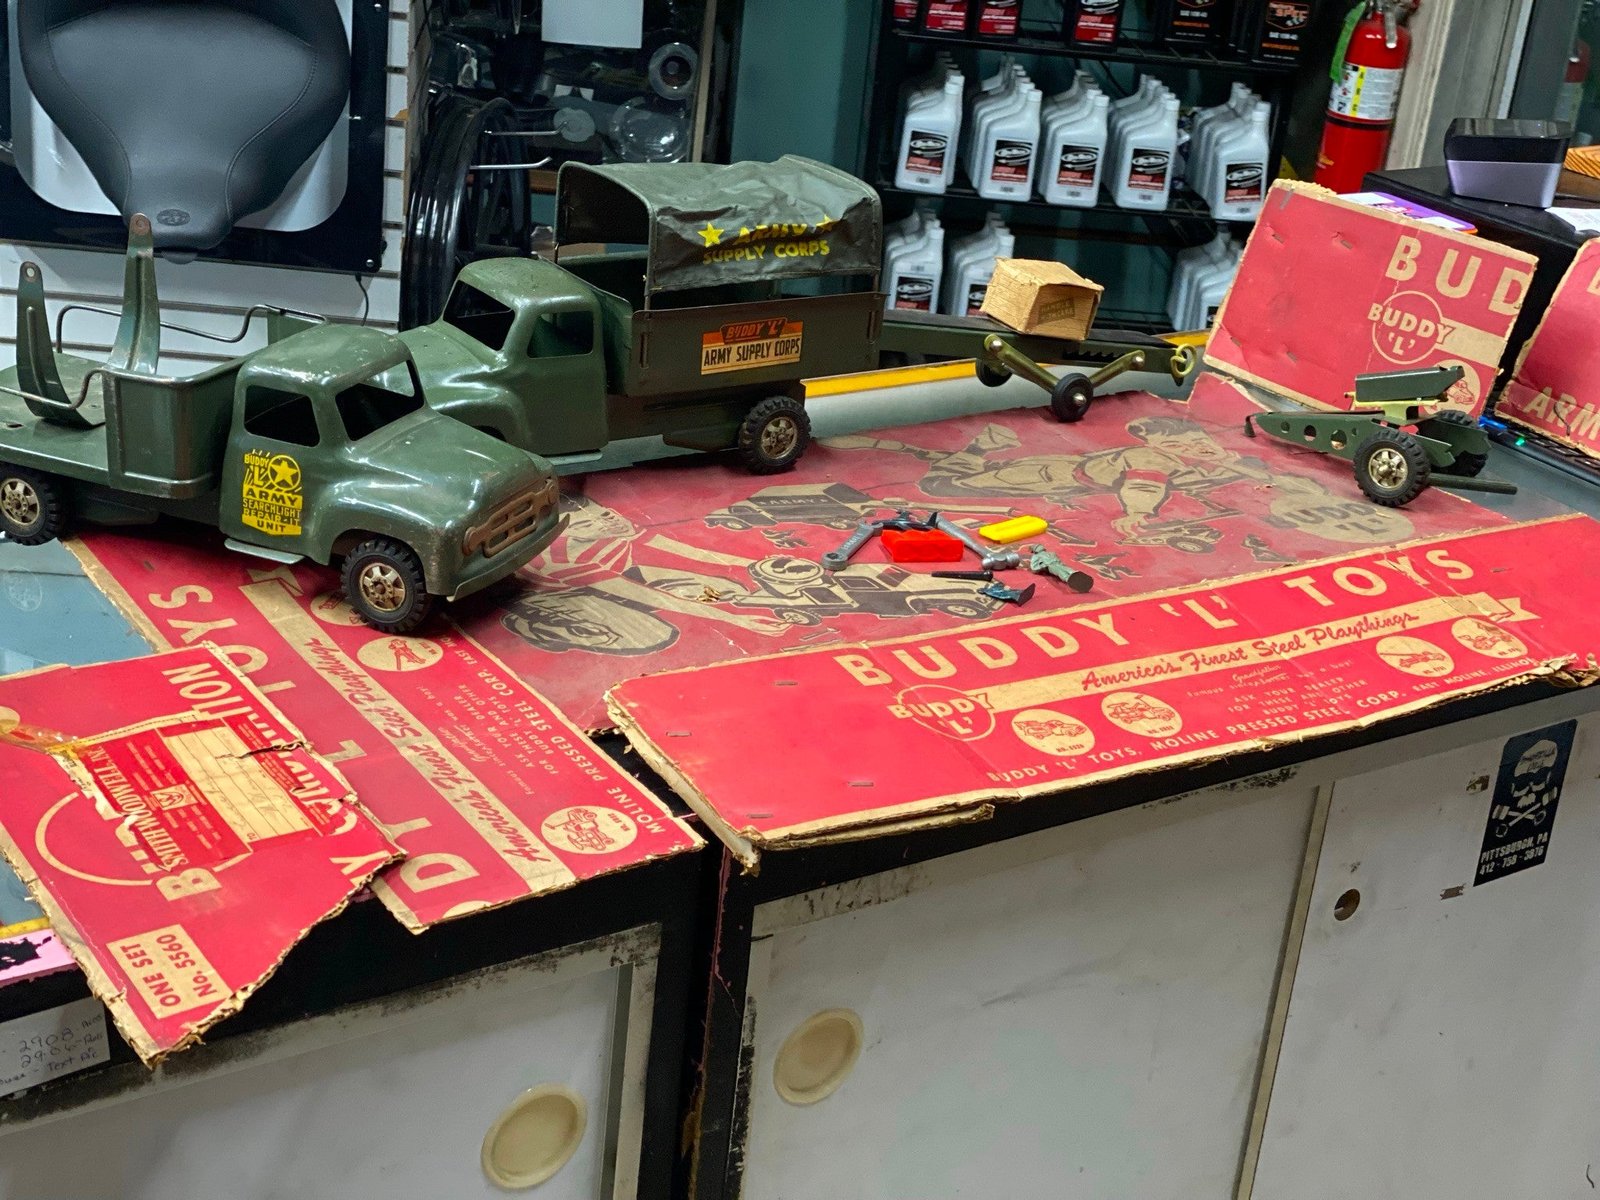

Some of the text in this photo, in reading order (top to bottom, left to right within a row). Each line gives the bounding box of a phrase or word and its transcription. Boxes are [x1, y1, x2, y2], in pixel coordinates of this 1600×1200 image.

[703, 240, 831, 264] SUPPLY CORPS
[725, 323, 763, 339] BUDDY
[1367, 303, 1456, 344] BUDDY
[704, 338, 800, 367] ARMY SUPPLY CORPS
[244, 453, 269, 468] BUDDY
[243, 498, 301, 518] SEARCHLIGHT
[246, 488, 298, 506] ARMY
[243, 508, 299, 526] REPAIR-IT
[257, 520, 286, 532] UNIT
[835, 613, 1129, 687] BUDDY
[1283, 549, 1475, 607] TOYS
[453, 648, 478, 664] EAST
[1082, 612, 1419, 690] America's Finest Steel Playthings
[476, 667, 517, 693] CORP.
[1234, 677, 1344, 703] ASK YOUR DEALER
[487, 694, 512, 713] TOYS
[887, 692, 993, 719] BUDDY
[1227, 704, 1250, 713] FOR
[1259, 697, 1293, 707] THESE
[1332, 679, 1368, 693] OTHER
[515, 699, 552, 730] STEEL
[1263, 704, 1299, 715] BUDDY
[453, 693, 534, 765] ASK YOUR DEALER
[458, 682, 559, 772] FOR THESE AND OTHER
[986, 763, 1049, 782] BUDDY
[1151, 728, 1219, 751] MOLINE
[1226, 715, 1297, 735] PRESSED
[1303, 705, 1350, 721] STEEL
[1356, 690, 1407, 709] CORP.
[1413, 682, 1442, 692] EAST
[311, 637, 550, 861] America's Finest Steel Playthings
[523, 728, 554, 753] BUDDY
[551, 733, 607, 780] PRESSED
[608, 786, 665, 831] MOLINE
[1537, 832, 1548, 844] PA
[1479, 863, 1494, 875] 412
[119, 941, 181, 1009] ONE SET
[155, 932, 216, 996] No. 5560
